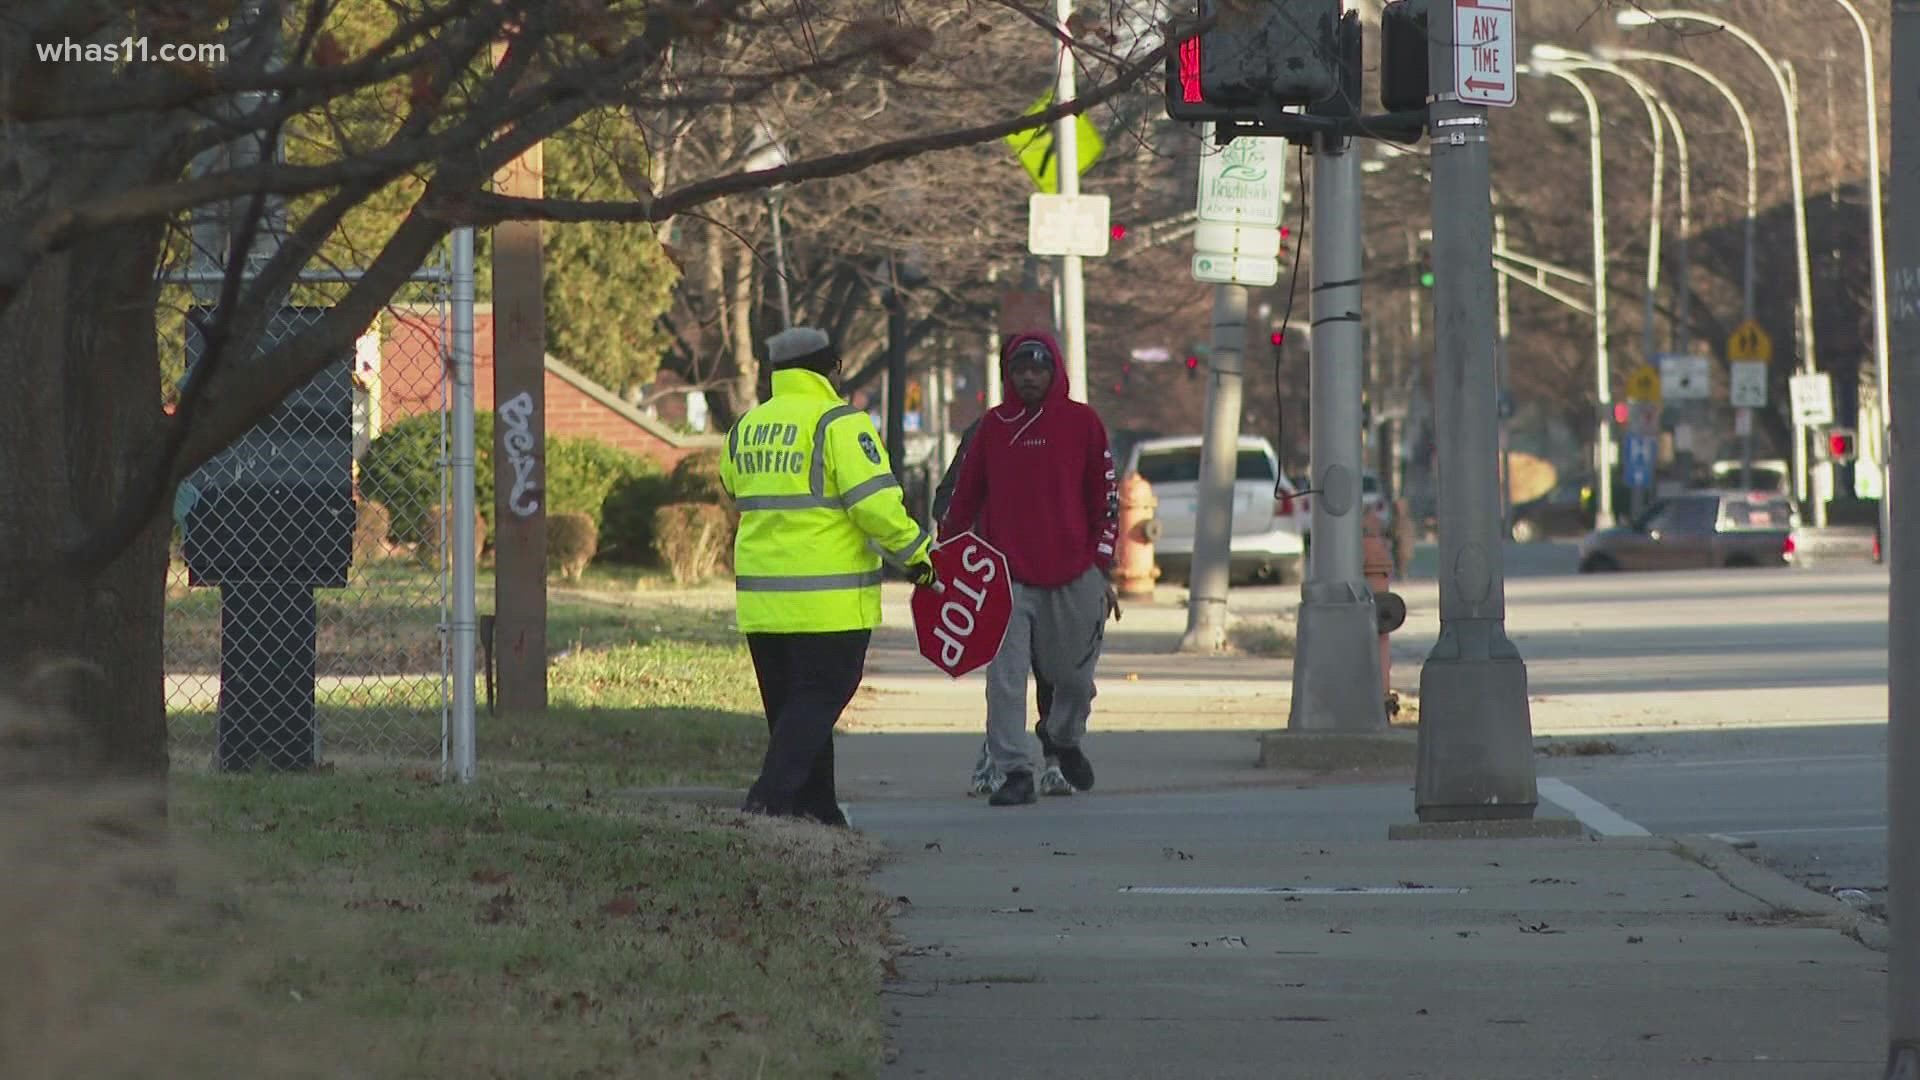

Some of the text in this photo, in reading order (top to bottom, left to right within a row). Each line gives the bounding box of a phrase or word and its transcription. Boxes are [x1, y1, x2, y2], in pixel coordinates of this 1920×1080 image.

[1472, 16, 1498, 41] ANY
[1472, 47, 1500, 73] TIME
[743, 423, 798, 446] LMPD
[735, 450, 804, 475] TRAFFIC
[933, 544, 996, 668] STOP
